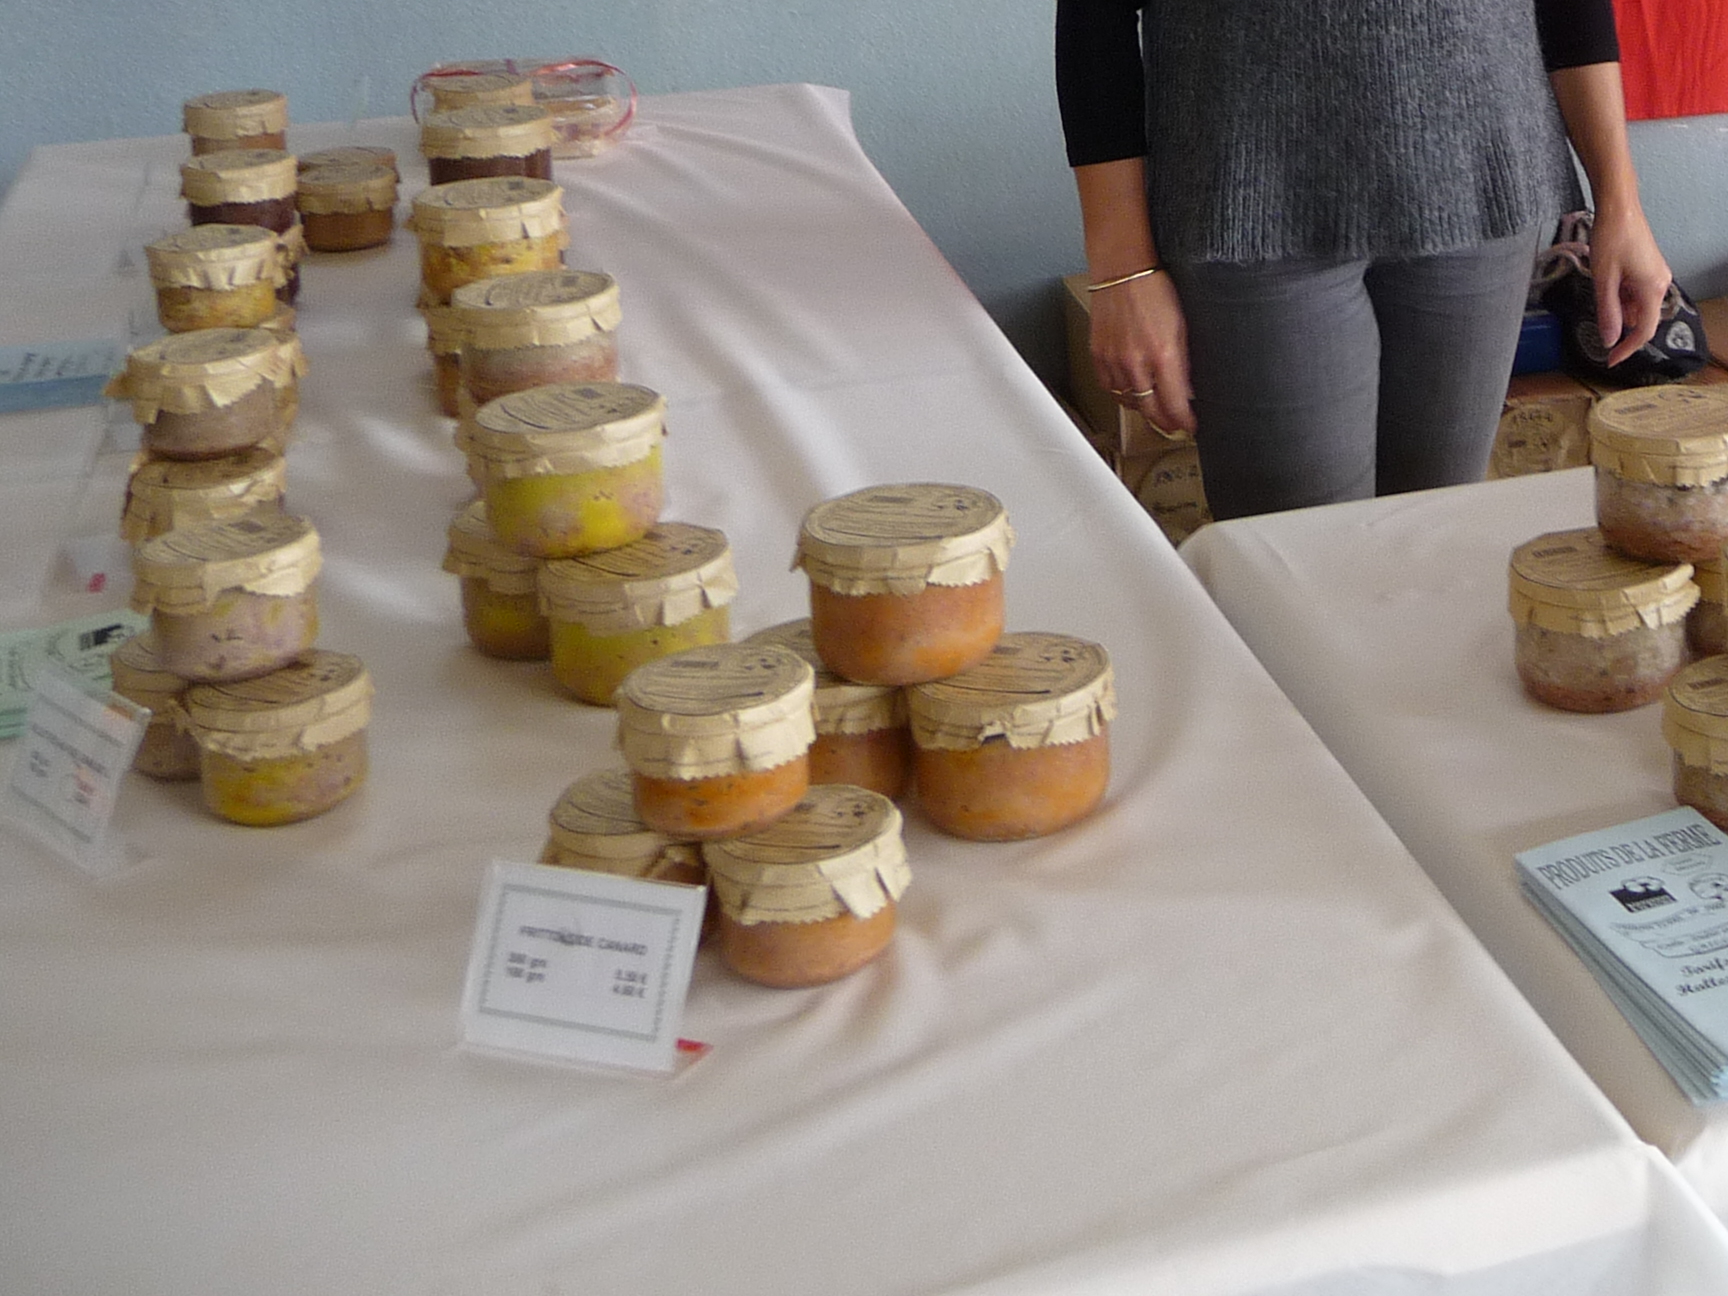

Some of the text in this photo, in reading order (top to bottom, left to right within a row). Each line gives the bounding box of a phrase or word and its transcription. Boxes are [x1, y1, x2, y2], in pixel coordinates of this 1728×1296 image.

[1537, 849, 1622, 891] PRODUITS
[1608, 842, 1646, 865] DE
[1632, 839, 1666, 860] LA
[1652, 823, 1723, 855] FERME
